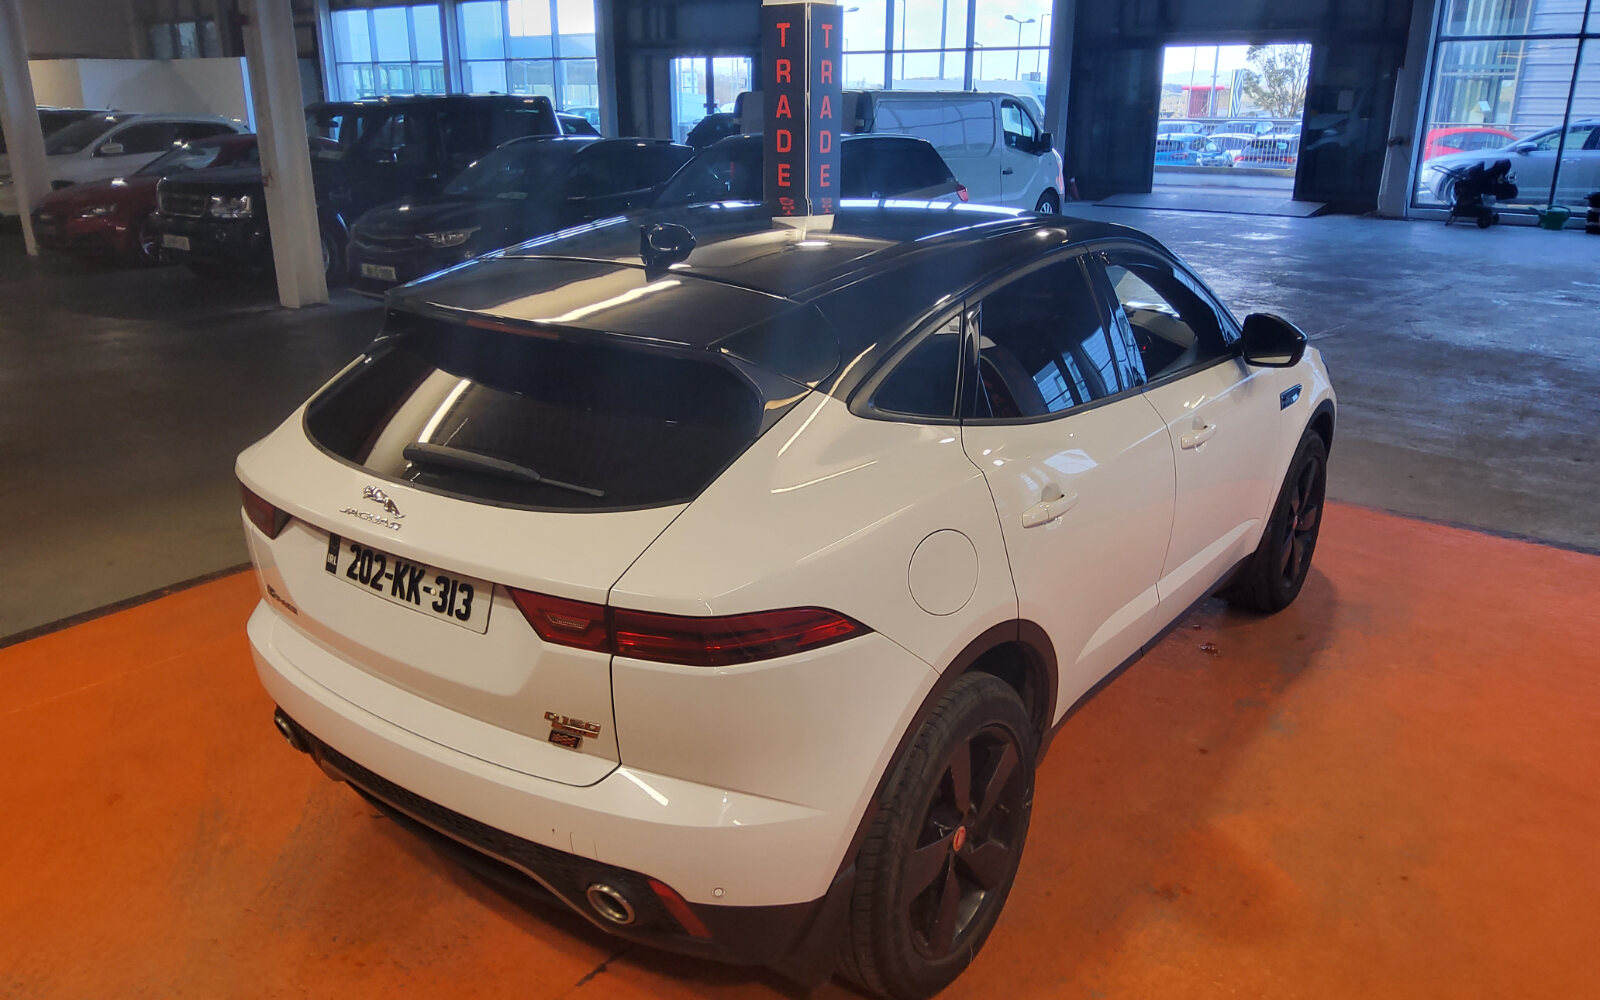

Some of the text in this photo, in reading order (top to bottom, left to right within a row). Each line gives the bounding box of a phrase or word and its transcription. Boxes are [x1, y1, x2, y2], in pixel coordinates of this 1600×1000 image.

[776, 22, 791, 187] TRADE
[820, 24, 832, 187] TRADE
[339, 507, 401, 531] JAGUAR
[346, 543, 474, 622] 202-KK-313
